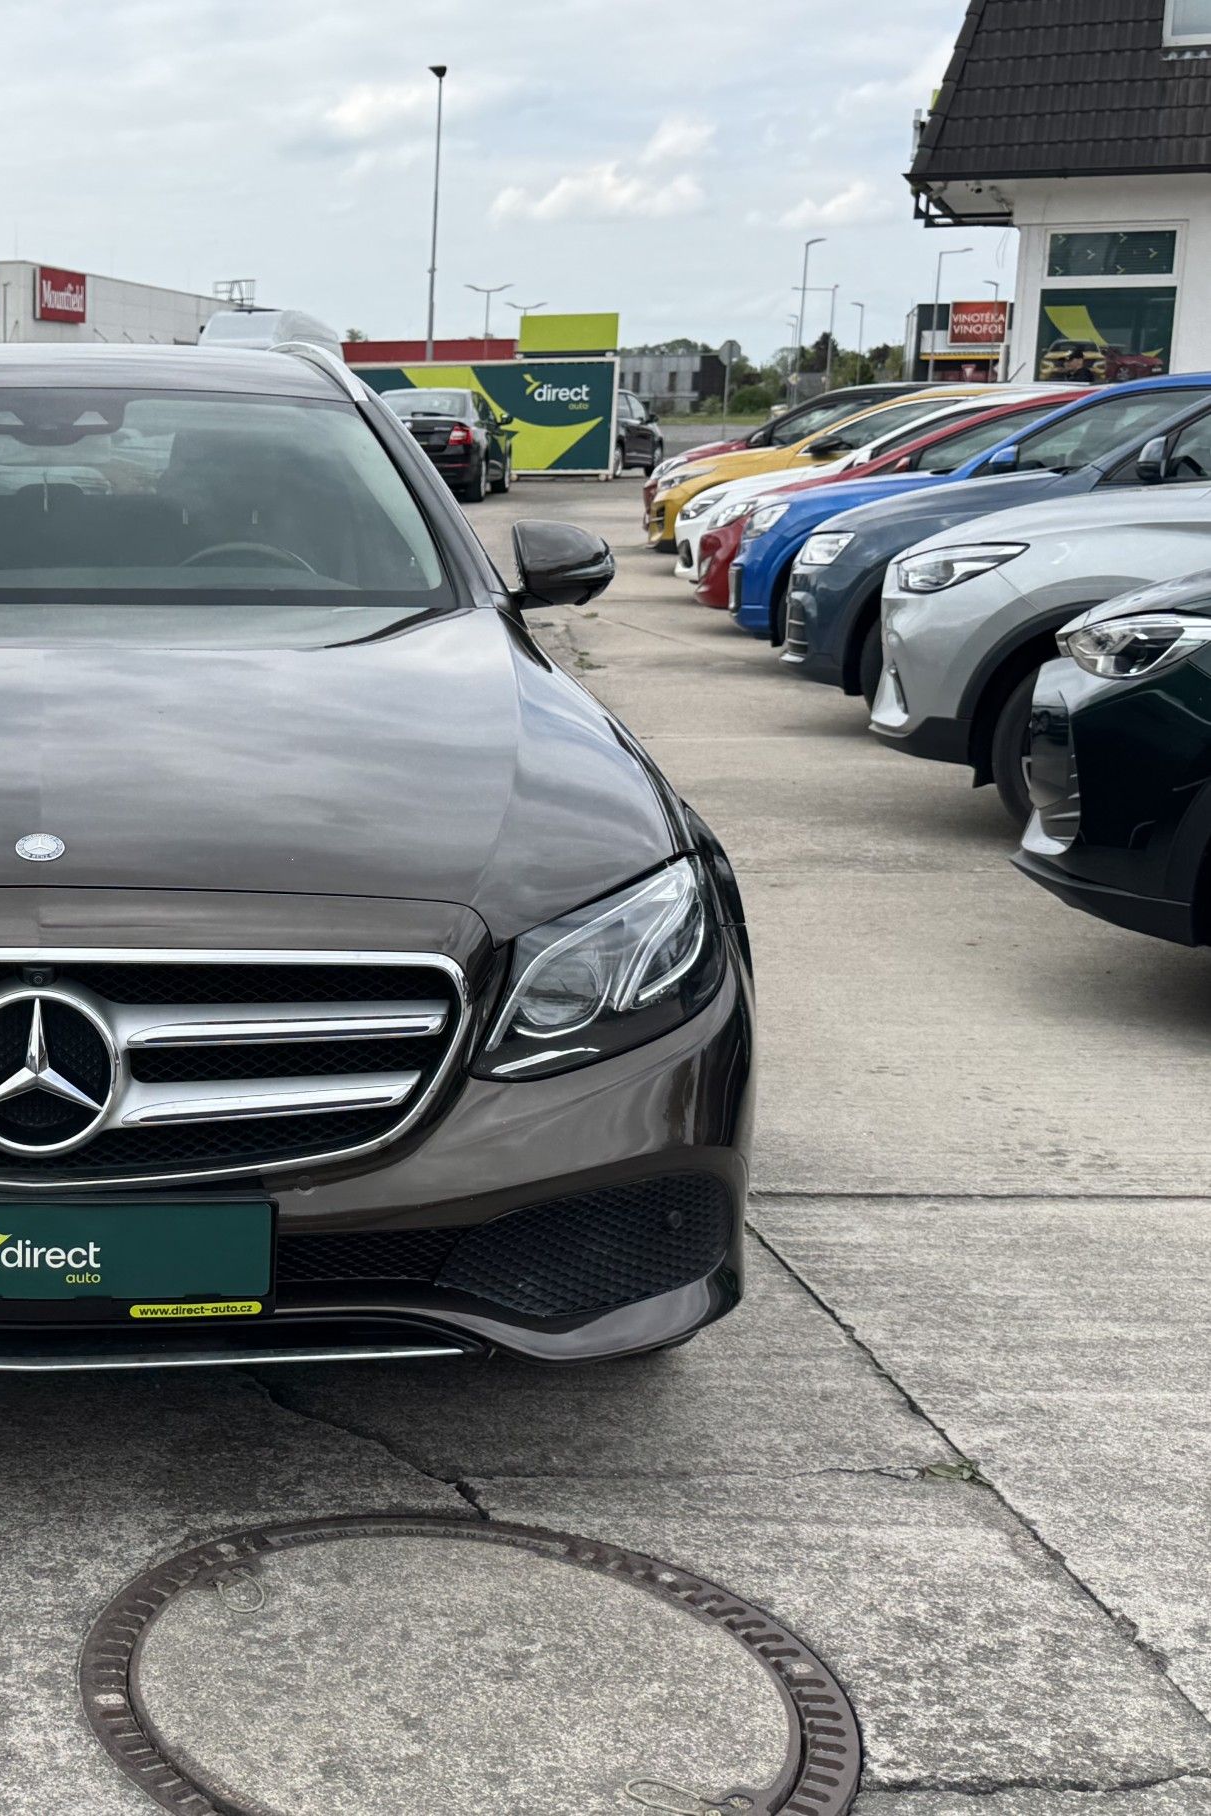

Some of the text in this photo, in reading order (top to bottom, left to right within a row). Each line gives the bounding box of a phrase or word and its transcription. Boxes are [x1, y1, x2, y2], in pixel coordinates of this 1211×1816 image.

[41, 279, 84, 312] Mountfield
[534, 384, 590, 401] direct
[0, 1239, 101, 1269] direct
[65, 1272, 101, 1284] auto
[138, 1303, 253, 1317] www.direct-auto.cz
